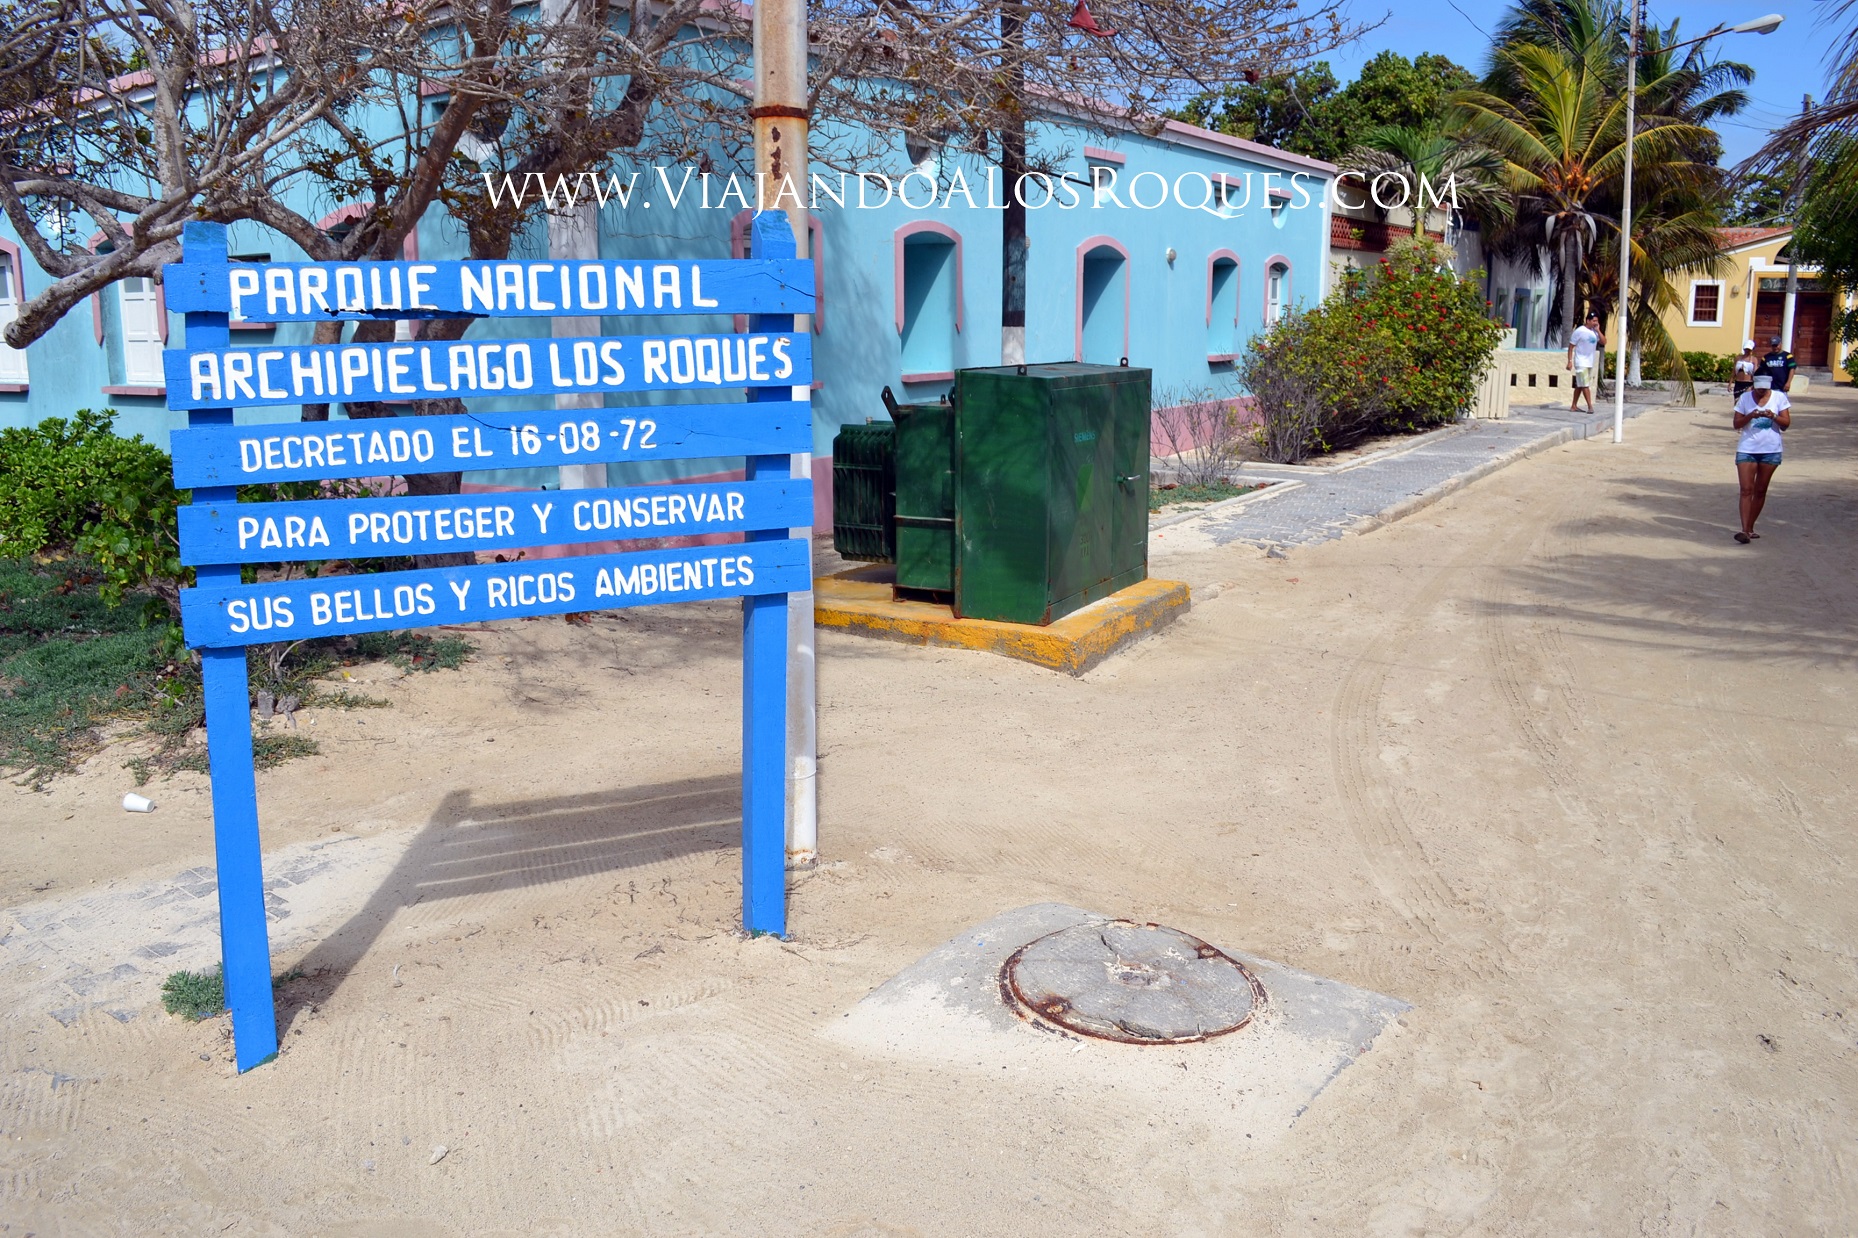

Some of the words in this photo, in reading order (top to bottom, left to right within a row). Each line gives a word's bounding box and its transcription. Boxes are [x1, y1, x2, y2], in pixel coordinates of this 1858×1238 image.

[228, 264, 439, 319] PARQUE
[460, 263, 720, 312] NACIONAL
[190, 342, 534, 402] ARCHIPIELAGO
[549, 339, 626, 388] LOS
[642, 336, 794, 385] ROQUES
[239, 429, 434, 474] DECRETADO
[452, 425, 494, 459] EL
[1073, 431, 1096, 444] SIEMENS
[238, 516, 330, 550] PARA
[348, 505, 515, 545] PROTEGER
[531, 502, 554, 534] Y
[573, 492, 746, 532] CONSERVAR
[227, 596, 295, 634] SUS
[310, 583, 436, 627] BELLOS
[449, 579, 472, 612] Y
[487, 571, 576, 609] RICOS
[595, 555, 755, 599] AMBIENTES
